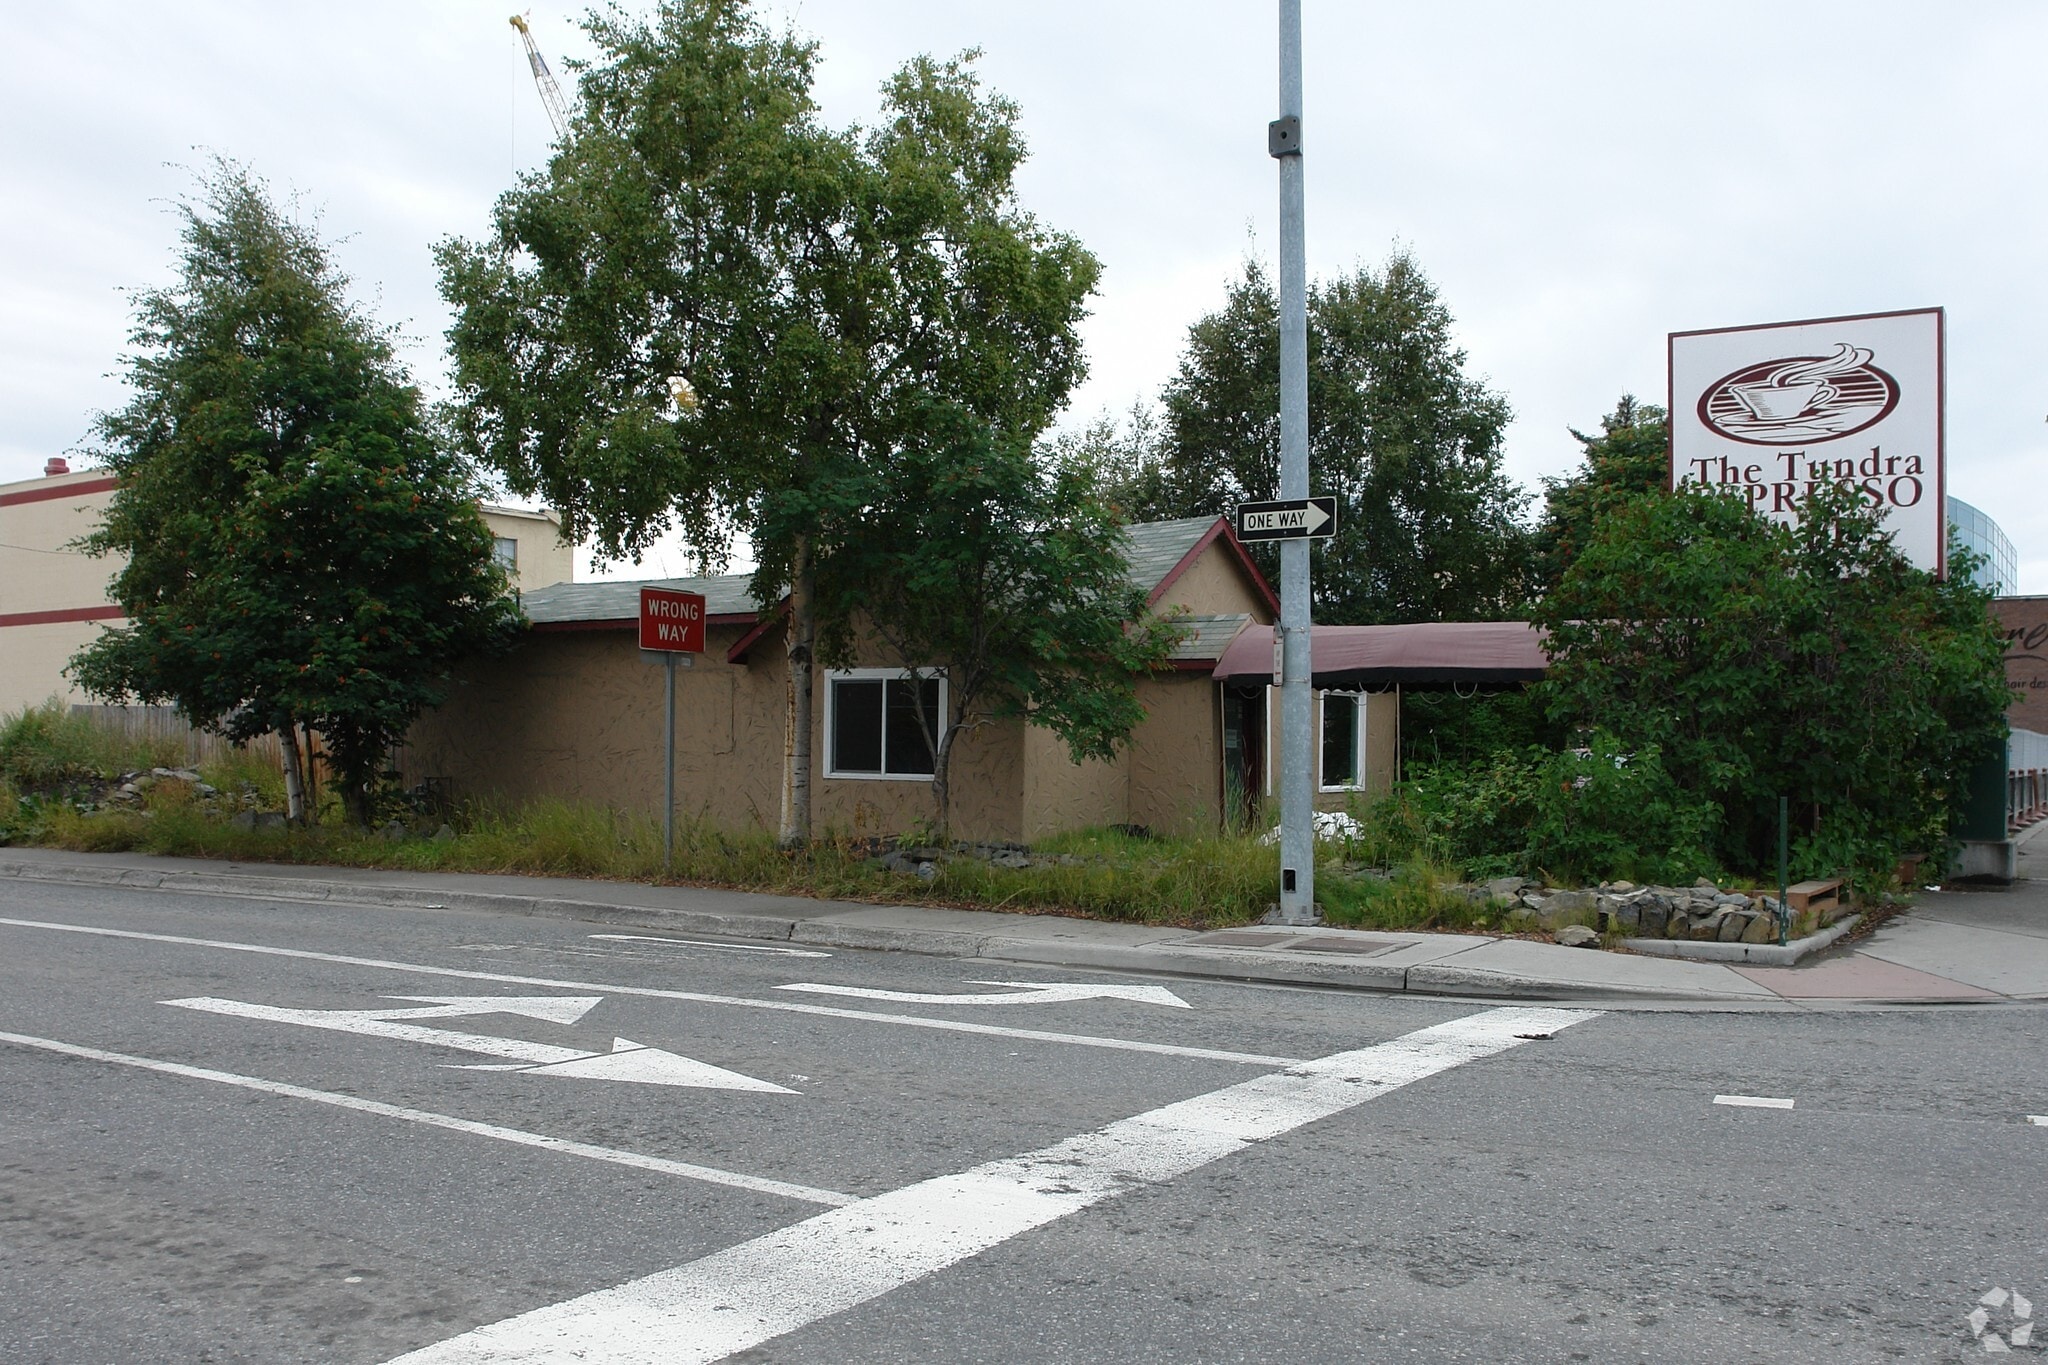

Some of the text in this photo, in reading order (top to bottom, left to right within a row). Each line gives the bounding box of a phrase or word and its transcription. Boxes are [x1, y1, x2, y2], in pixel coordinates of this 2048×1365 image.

[1689, 445, 1924, 484] The Tundra
[1248, 511, 1306, 529] ONE WAY
[648, 598, 699, 621] WRONG
[658, 623, 689, 643] WAY
